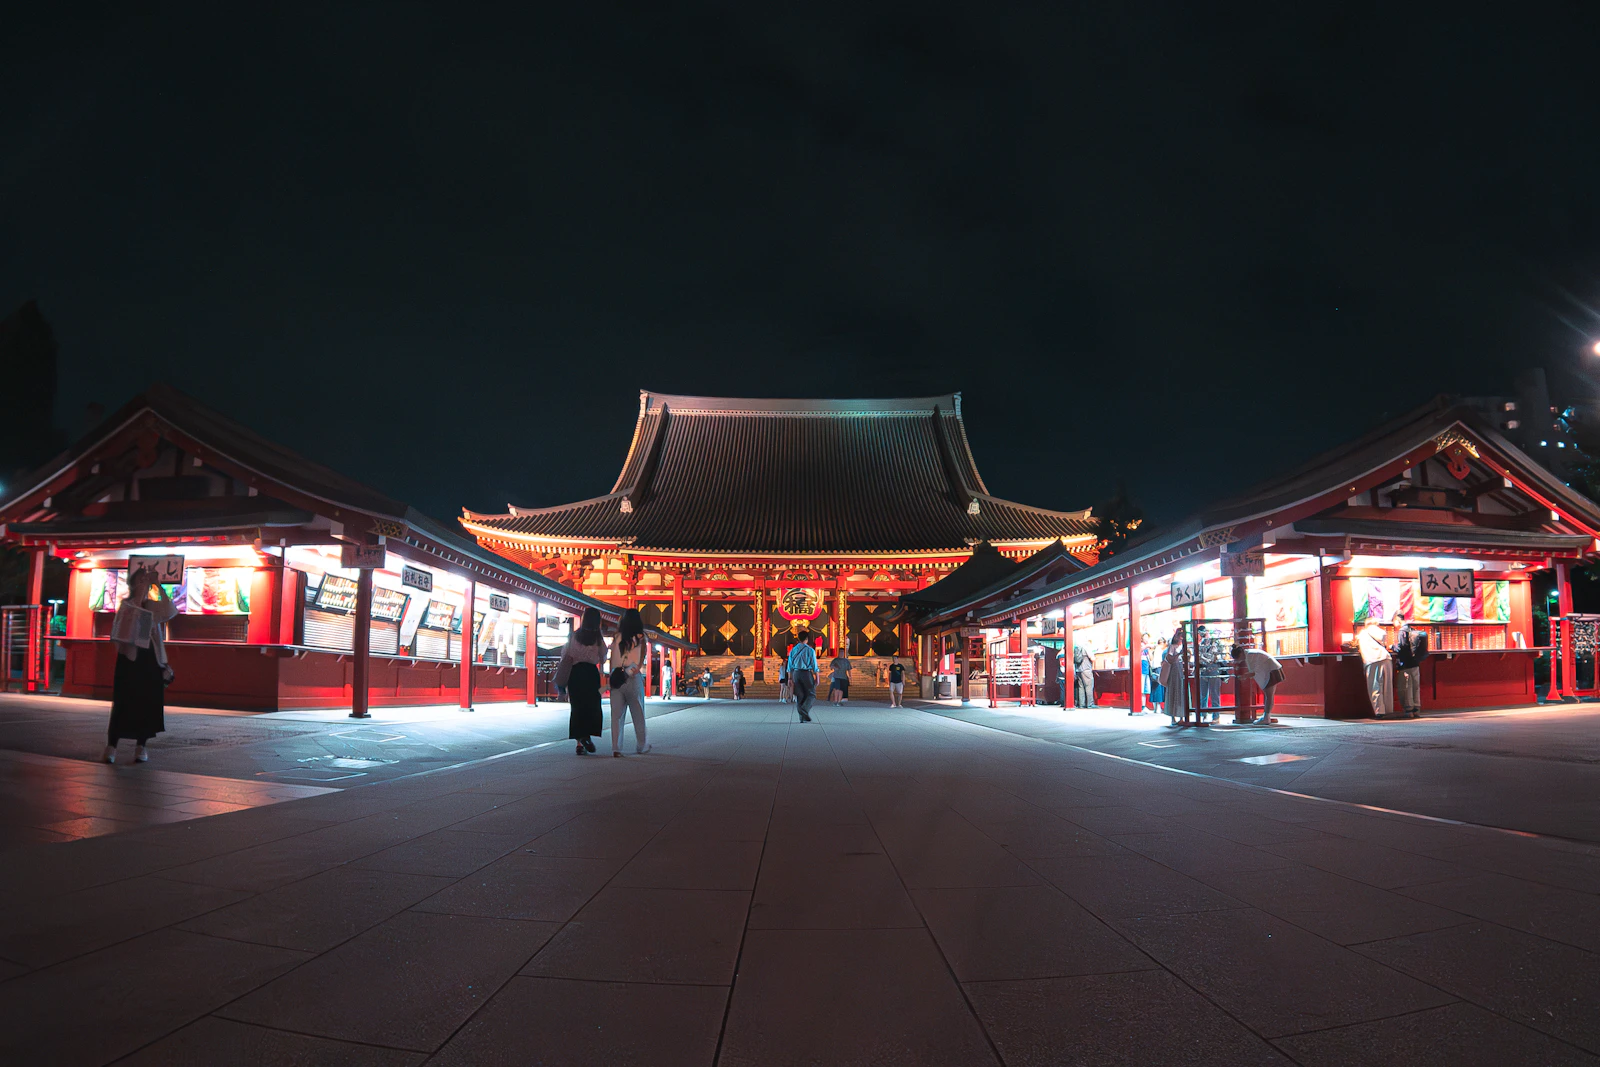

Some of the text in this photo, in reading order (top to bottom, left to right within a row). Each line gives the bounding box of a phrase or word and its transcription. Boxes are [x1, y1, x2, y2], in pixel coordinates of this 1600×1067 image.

[1427, 574, 1467, 590] みくじ
[1175, 582, 1201, 602] みくじ
[1096, 604, 1111, 617] みくじ
